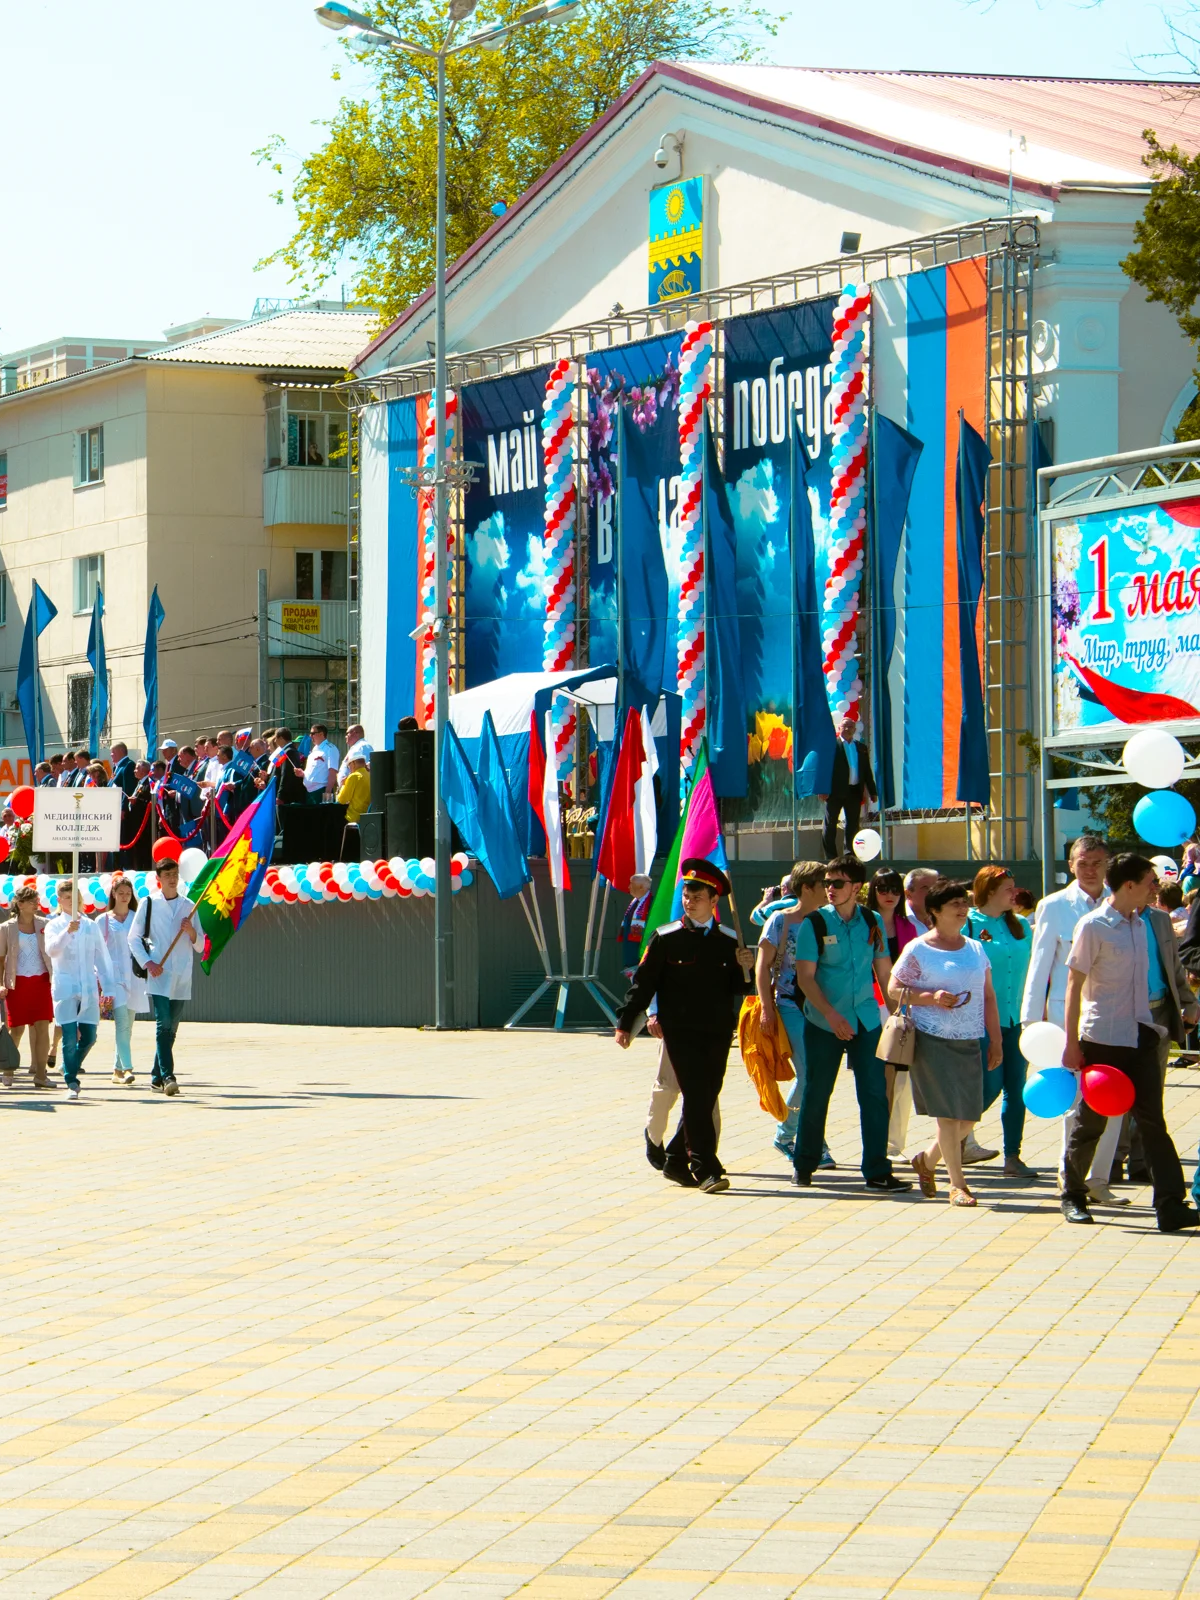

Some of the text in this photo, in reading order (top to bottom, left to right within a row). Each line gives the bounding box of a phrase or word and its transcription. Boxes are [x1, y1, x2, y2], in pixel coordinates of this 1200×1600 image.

[487, 409, 539, 497] май
[1091, 539, 1113, 620] 1
[283, 607, 318, 618] ПРОДАМ
[1081, 637, 1120, 673] Мир,
[43, 813, 113, 821] МЕДИЦИНСКИЙ
